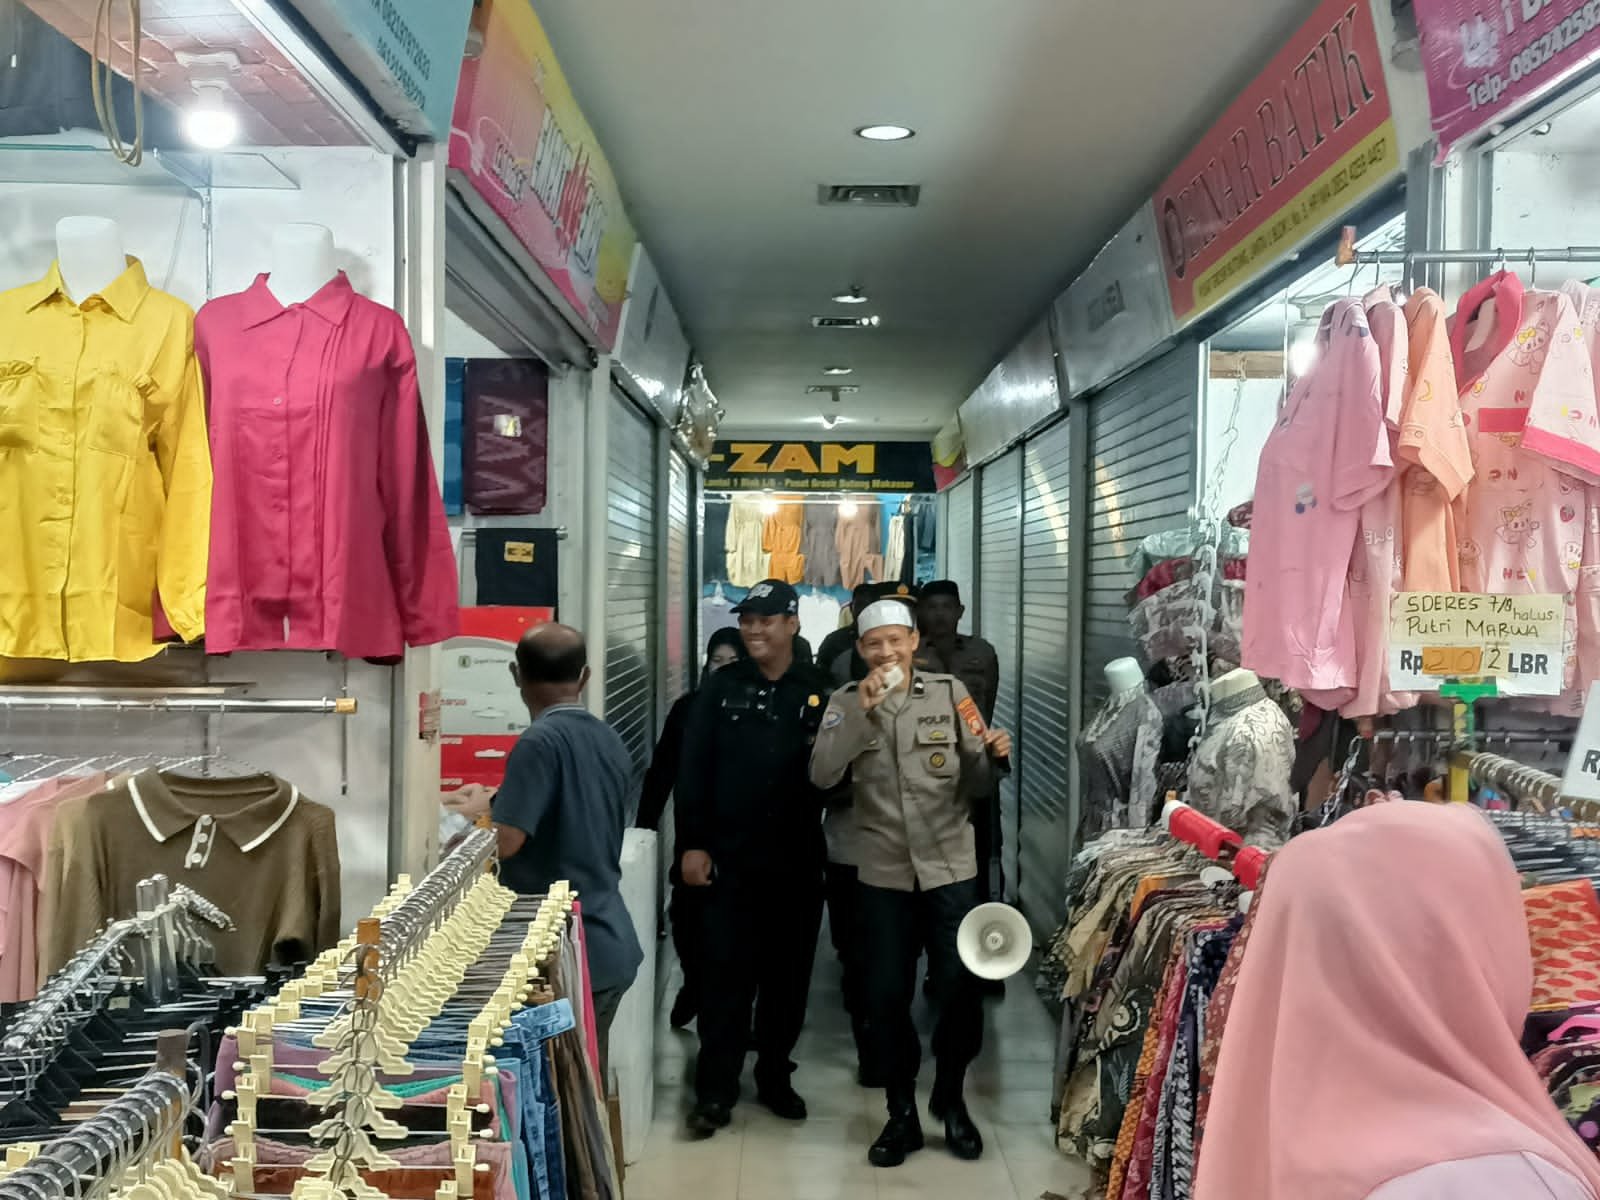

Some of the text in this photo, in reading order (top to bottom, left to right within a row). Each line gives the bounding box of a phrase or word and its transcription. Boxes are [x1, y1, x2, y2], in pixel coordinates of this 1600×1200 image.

[1256, 4, 1374, 189] BATIK
[1405, 595, 1483, 613] SDERES
[1405, 615, 1451, 637] Putri
[1400, 649, 1423, 675] Rp
[1507, 652, 1549, 675] LBR
[917, 714, 952, 727] POLRI
